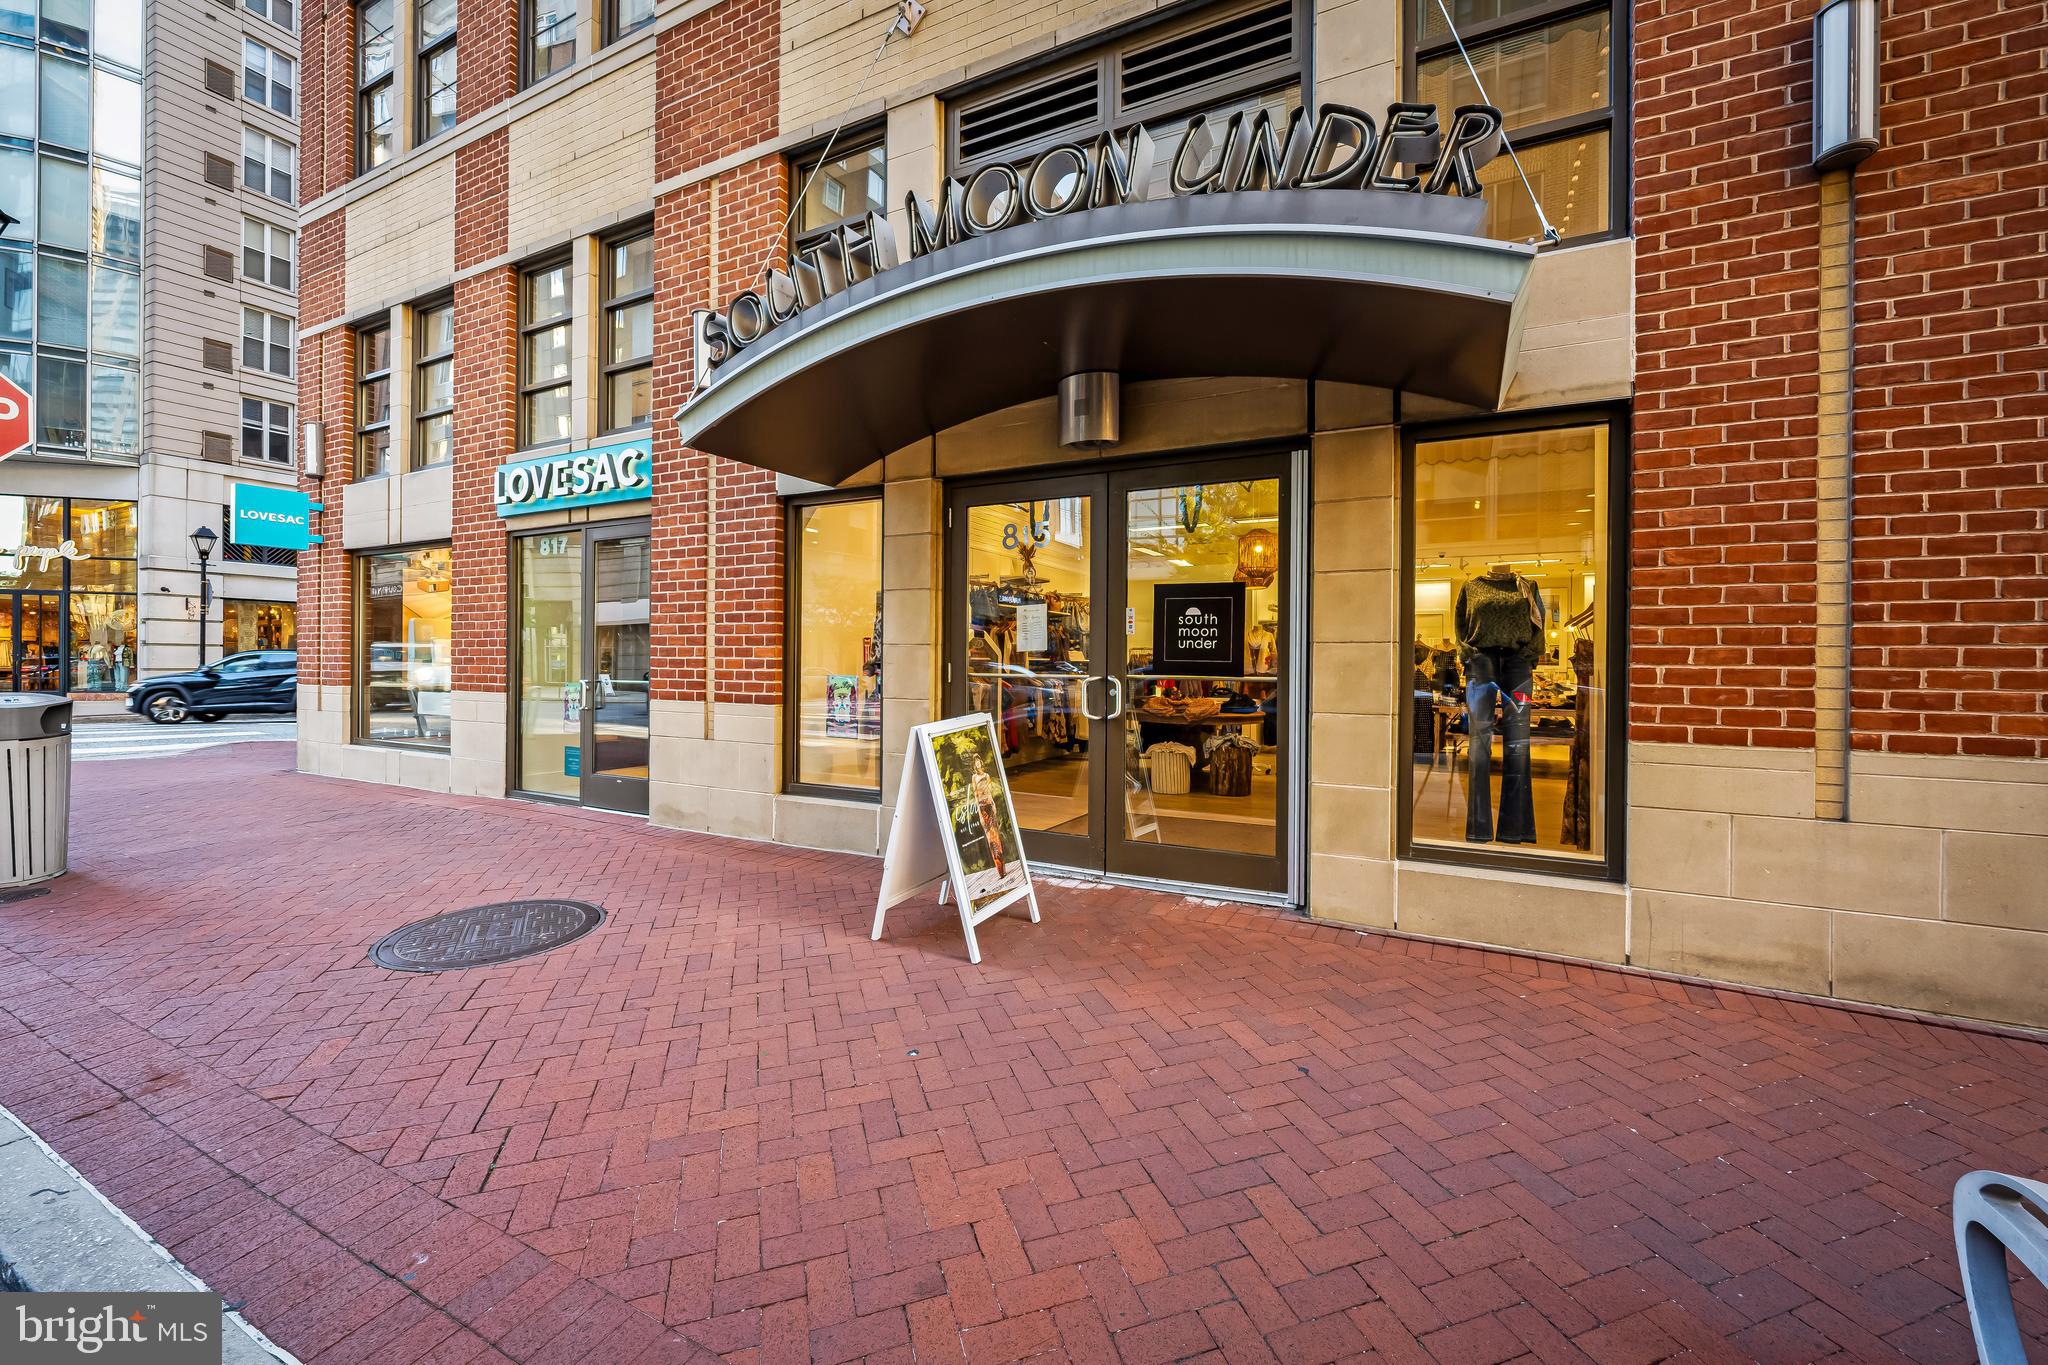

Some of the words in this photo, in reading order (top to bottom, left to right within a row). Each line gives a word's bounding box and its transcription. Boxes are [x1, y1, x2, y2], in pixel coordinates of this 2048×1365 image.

[703, 210, 899, 370] SOUTH
[904, 121, 1154, 260] MOON
[1169, 102, 1503, 199] UNDER
[493, 447, 645, 505] LOVESAC
[240, 509, 305, 525] LOVESAC
[539, 535, 568, 556] 817
[1178, 613, 1218, 625] south
[1178, 627, 1218, 637] moon
[1178, 638, 1217, 649] under
